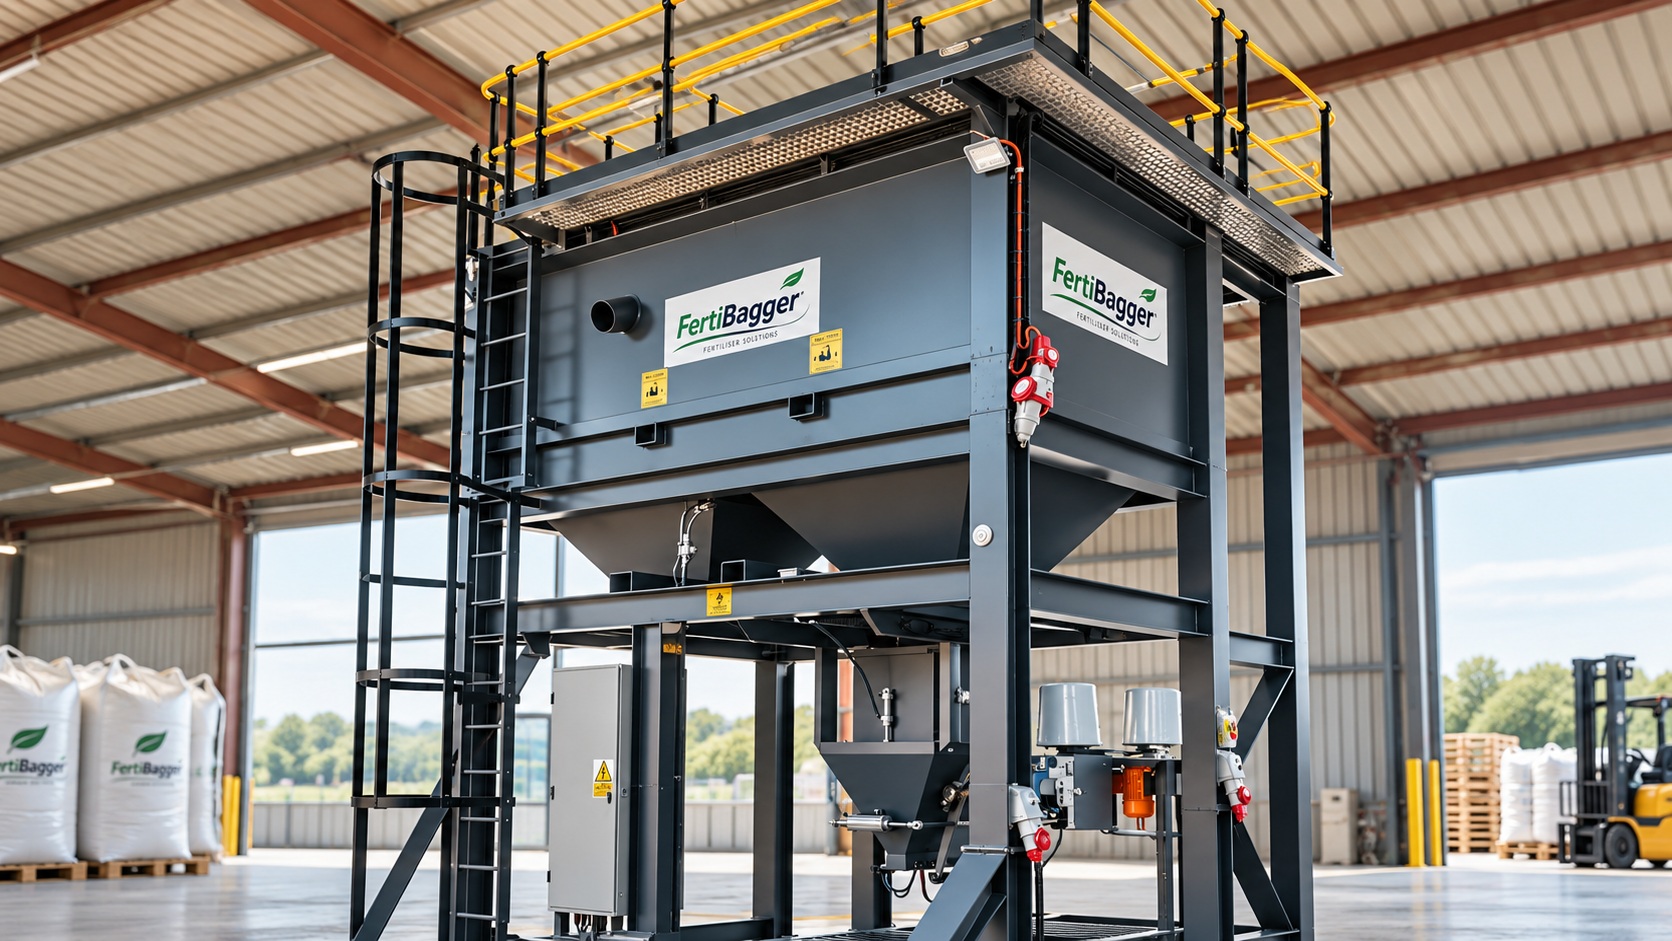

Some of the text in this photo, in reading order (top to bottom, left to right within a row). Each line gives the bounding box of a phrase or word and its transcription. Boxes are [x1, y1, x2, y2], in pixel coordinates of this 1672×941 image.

[676, 292, 800, 339] FertiBagger
[1052, 256, 1154, 328] FertiBagger
[0, 758, 64, 777] rtiBagger
